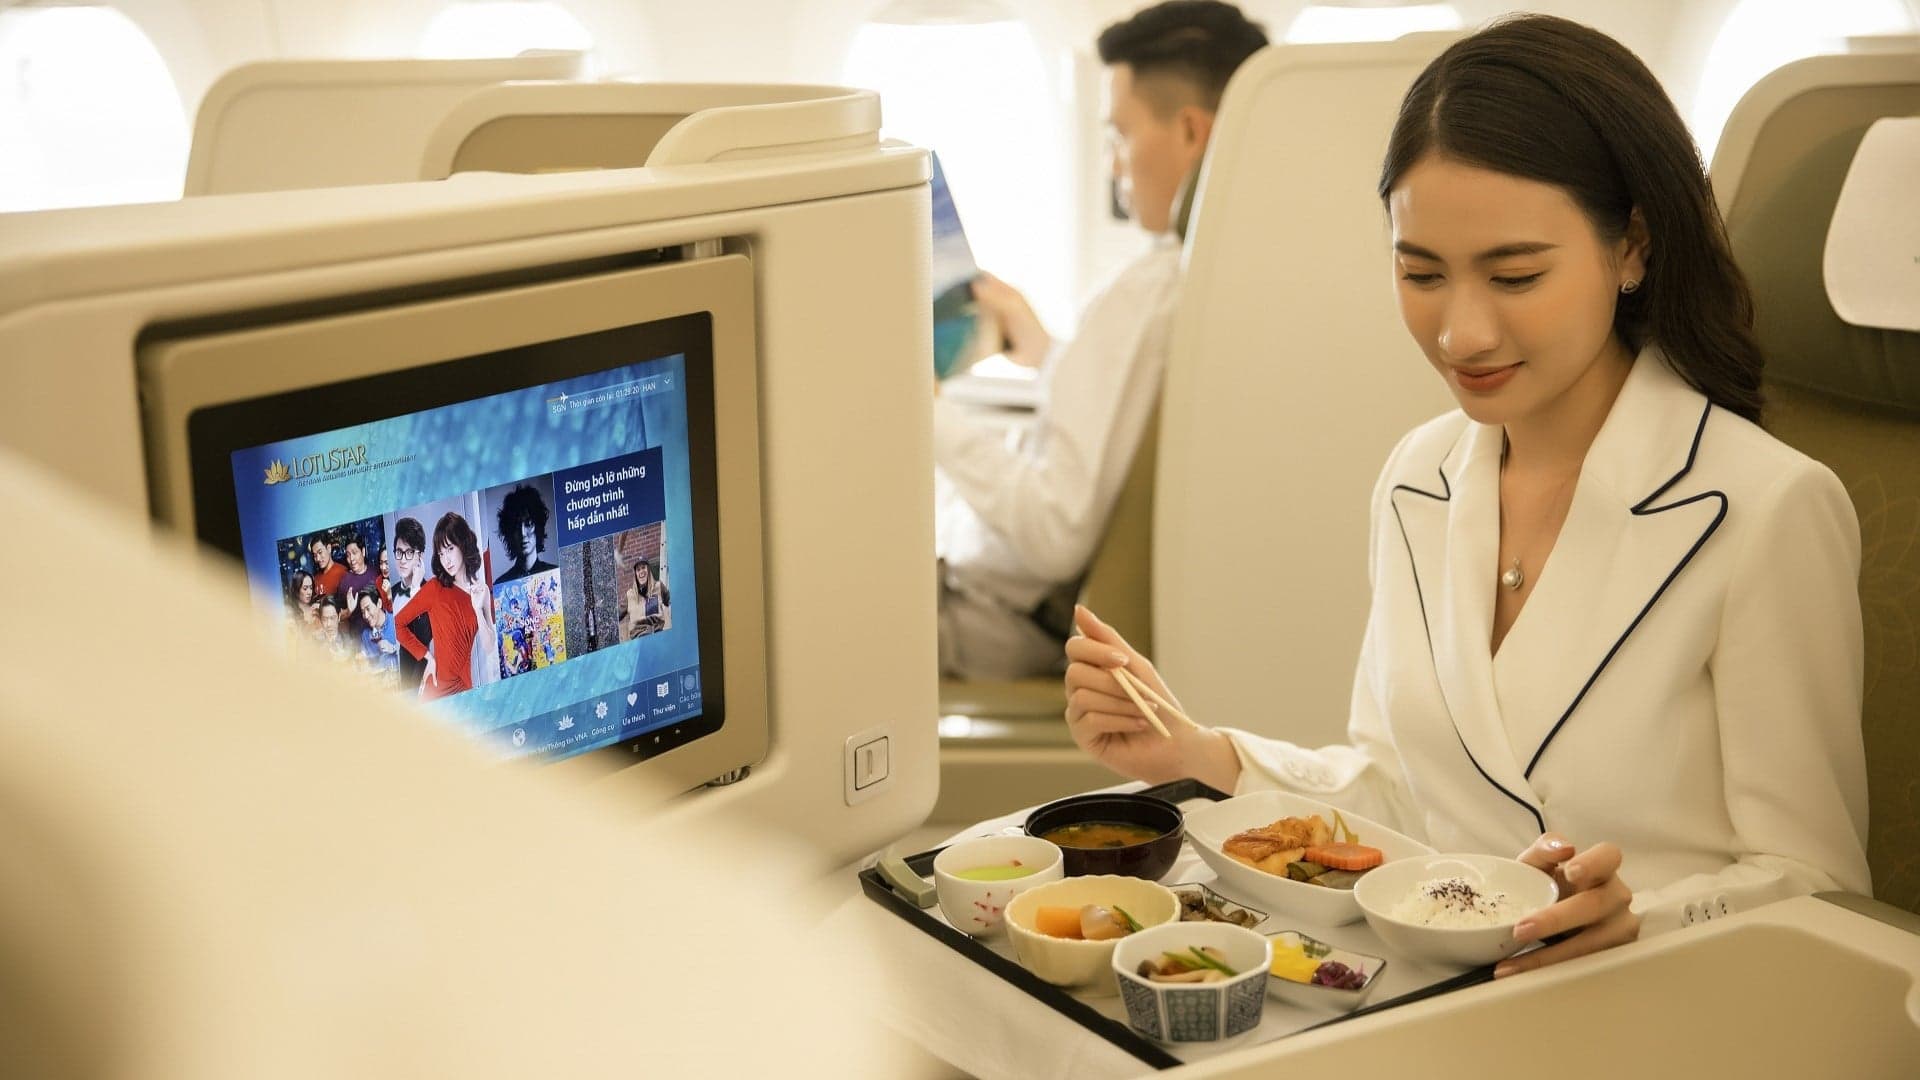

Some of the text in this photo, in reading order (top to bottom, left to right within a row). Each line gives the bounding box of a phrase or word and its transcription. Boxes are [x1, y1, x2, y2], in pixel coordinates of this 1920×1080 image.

[552, 403, 567, 414] SGN
[642, 381, 656, 392] HAN
[292, 445, 368, 480] LOTUSTAR
[565, 465, 646, 494] Đừng bỏ lỡ những
[566, 486, 625, 512] chương trình
[567, 503, 630, 531] hấp dẫn nhất!
